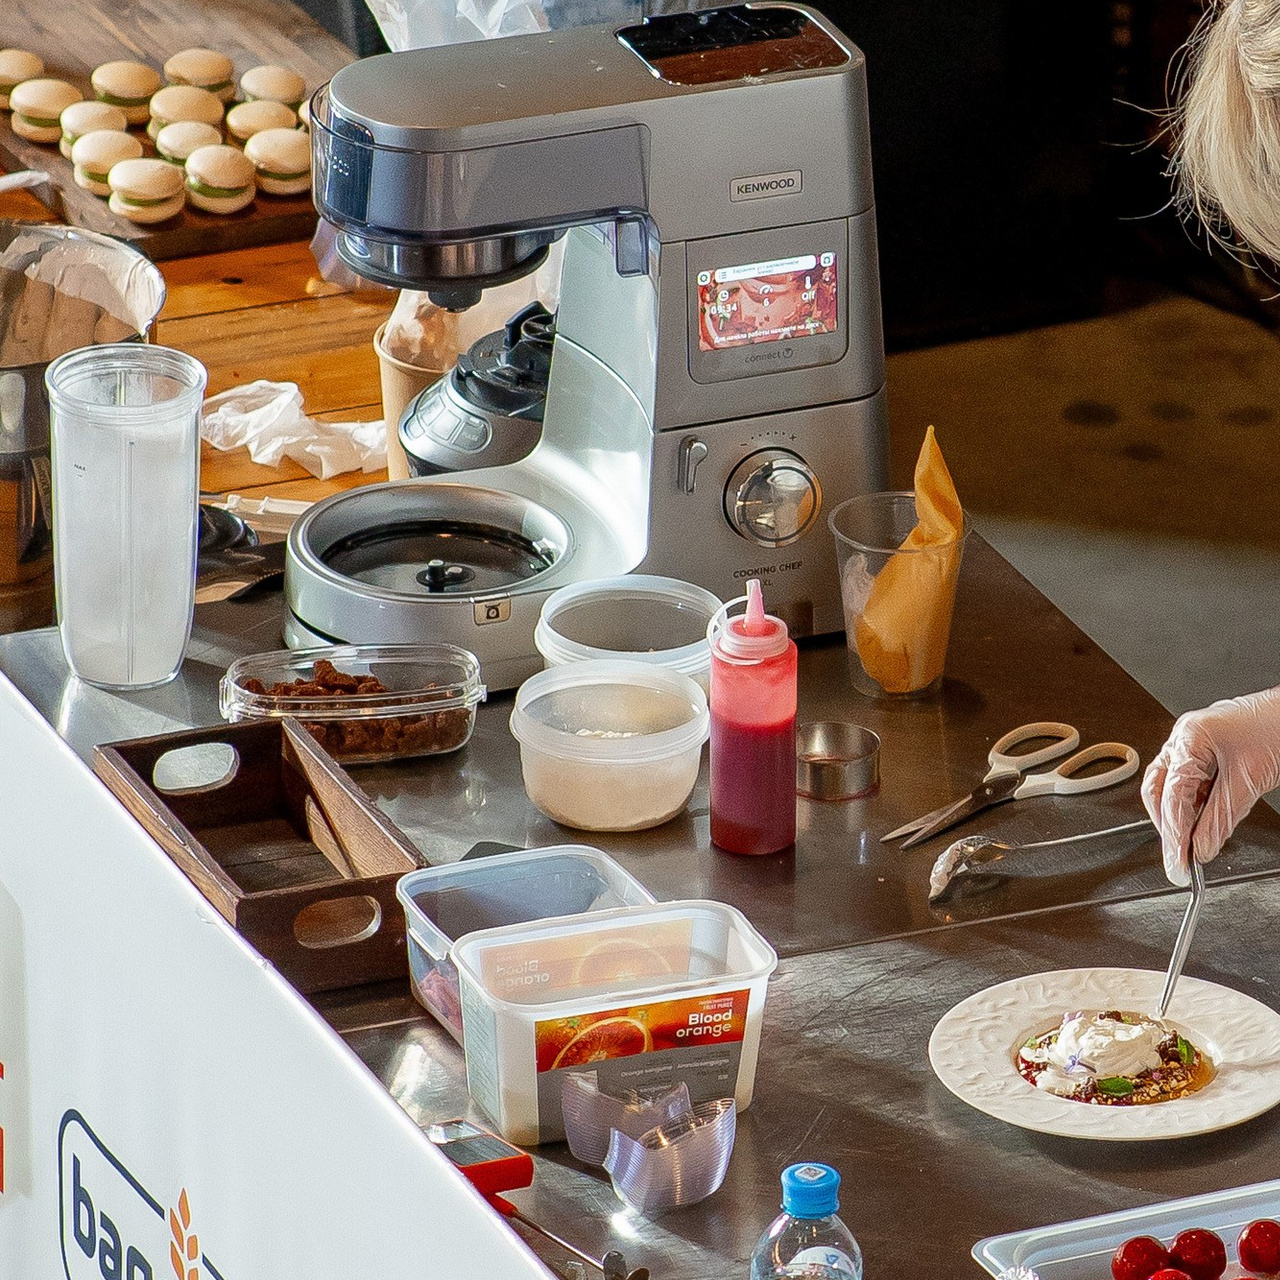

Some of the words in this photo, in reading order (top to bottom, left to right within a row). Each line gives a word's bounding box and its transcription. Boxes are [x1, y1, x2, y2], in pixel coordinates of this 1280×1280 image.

[737, 178, 795, 195] KENWOOD
[763, 298, 770, 307] 6
[745, 350, 781, 363] connect
[733, 565, 777, 579] COOKING
[778, 561, 803, 572] CHEF
[688, 1009, 732, 1025] Blood
[676, 1023, 732, 1038] orange
